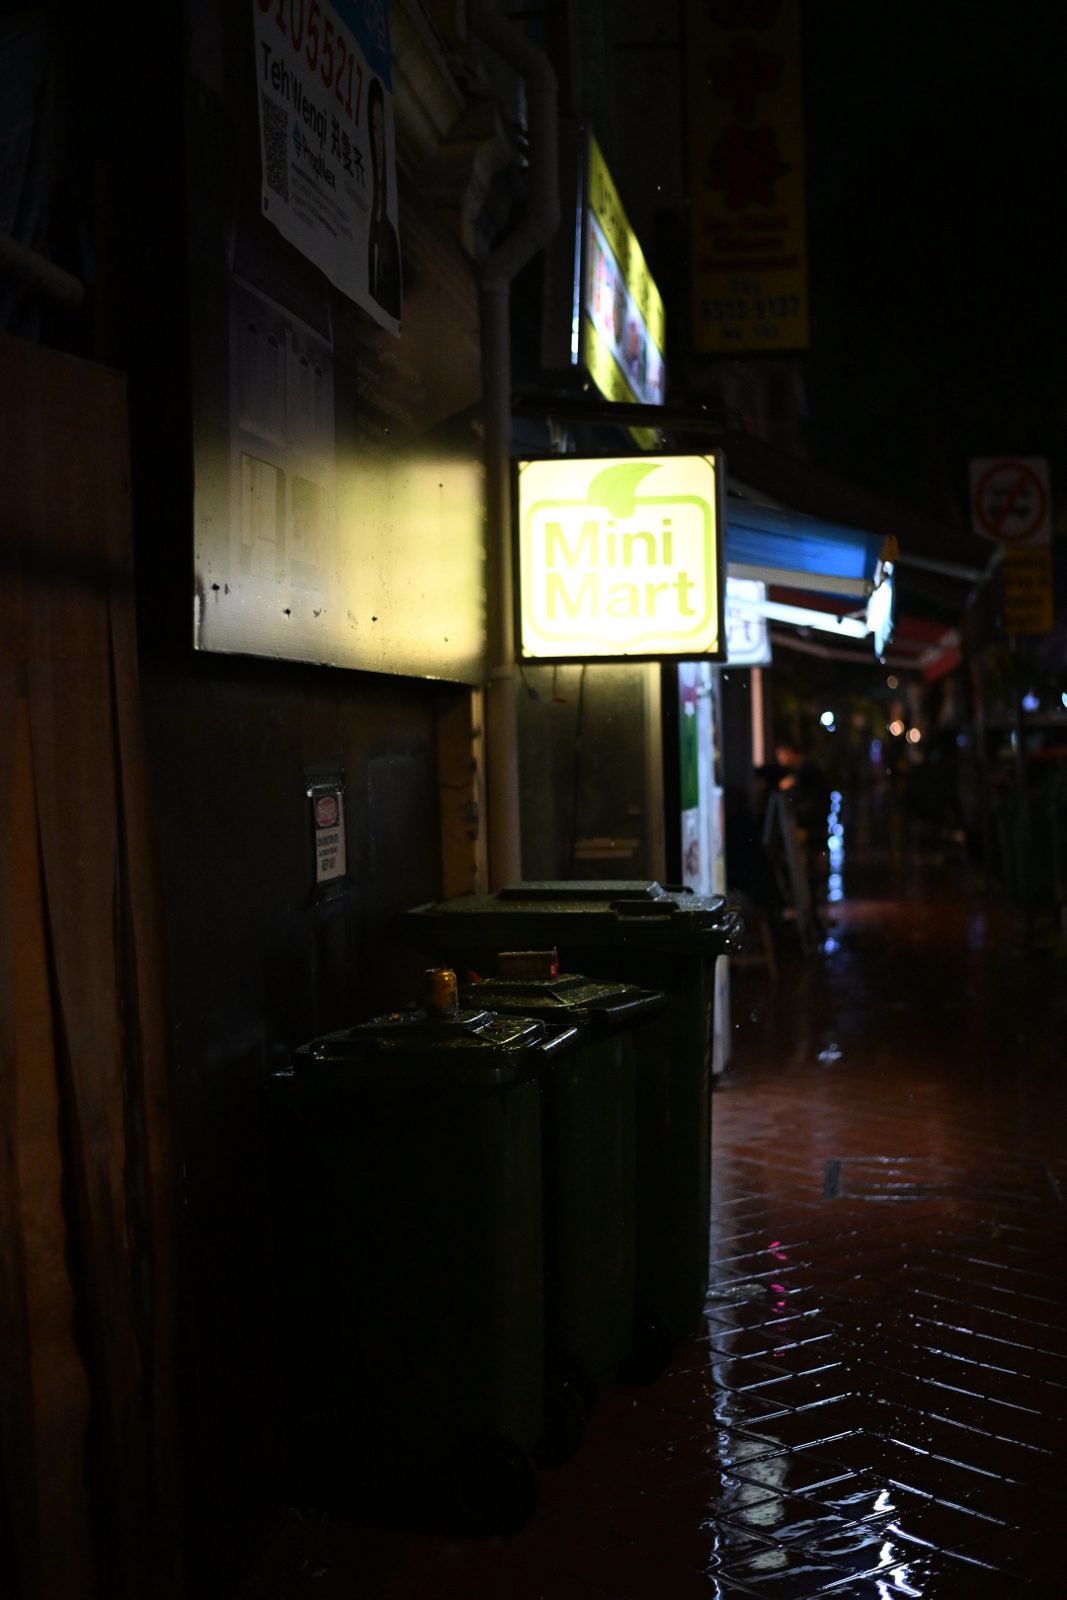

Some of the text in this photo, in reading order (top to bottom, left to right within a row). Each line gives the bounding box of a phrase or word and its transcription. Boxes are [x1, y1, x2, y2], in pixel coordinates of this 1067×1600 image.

[260, 0, 363, 127] 1055217
[261, 40, 290, 100] Teh
[290, 71, 327, 149] Wenqi
[544, 518, 673, 568] Mini
[545, 571, 696, 621] Mart
